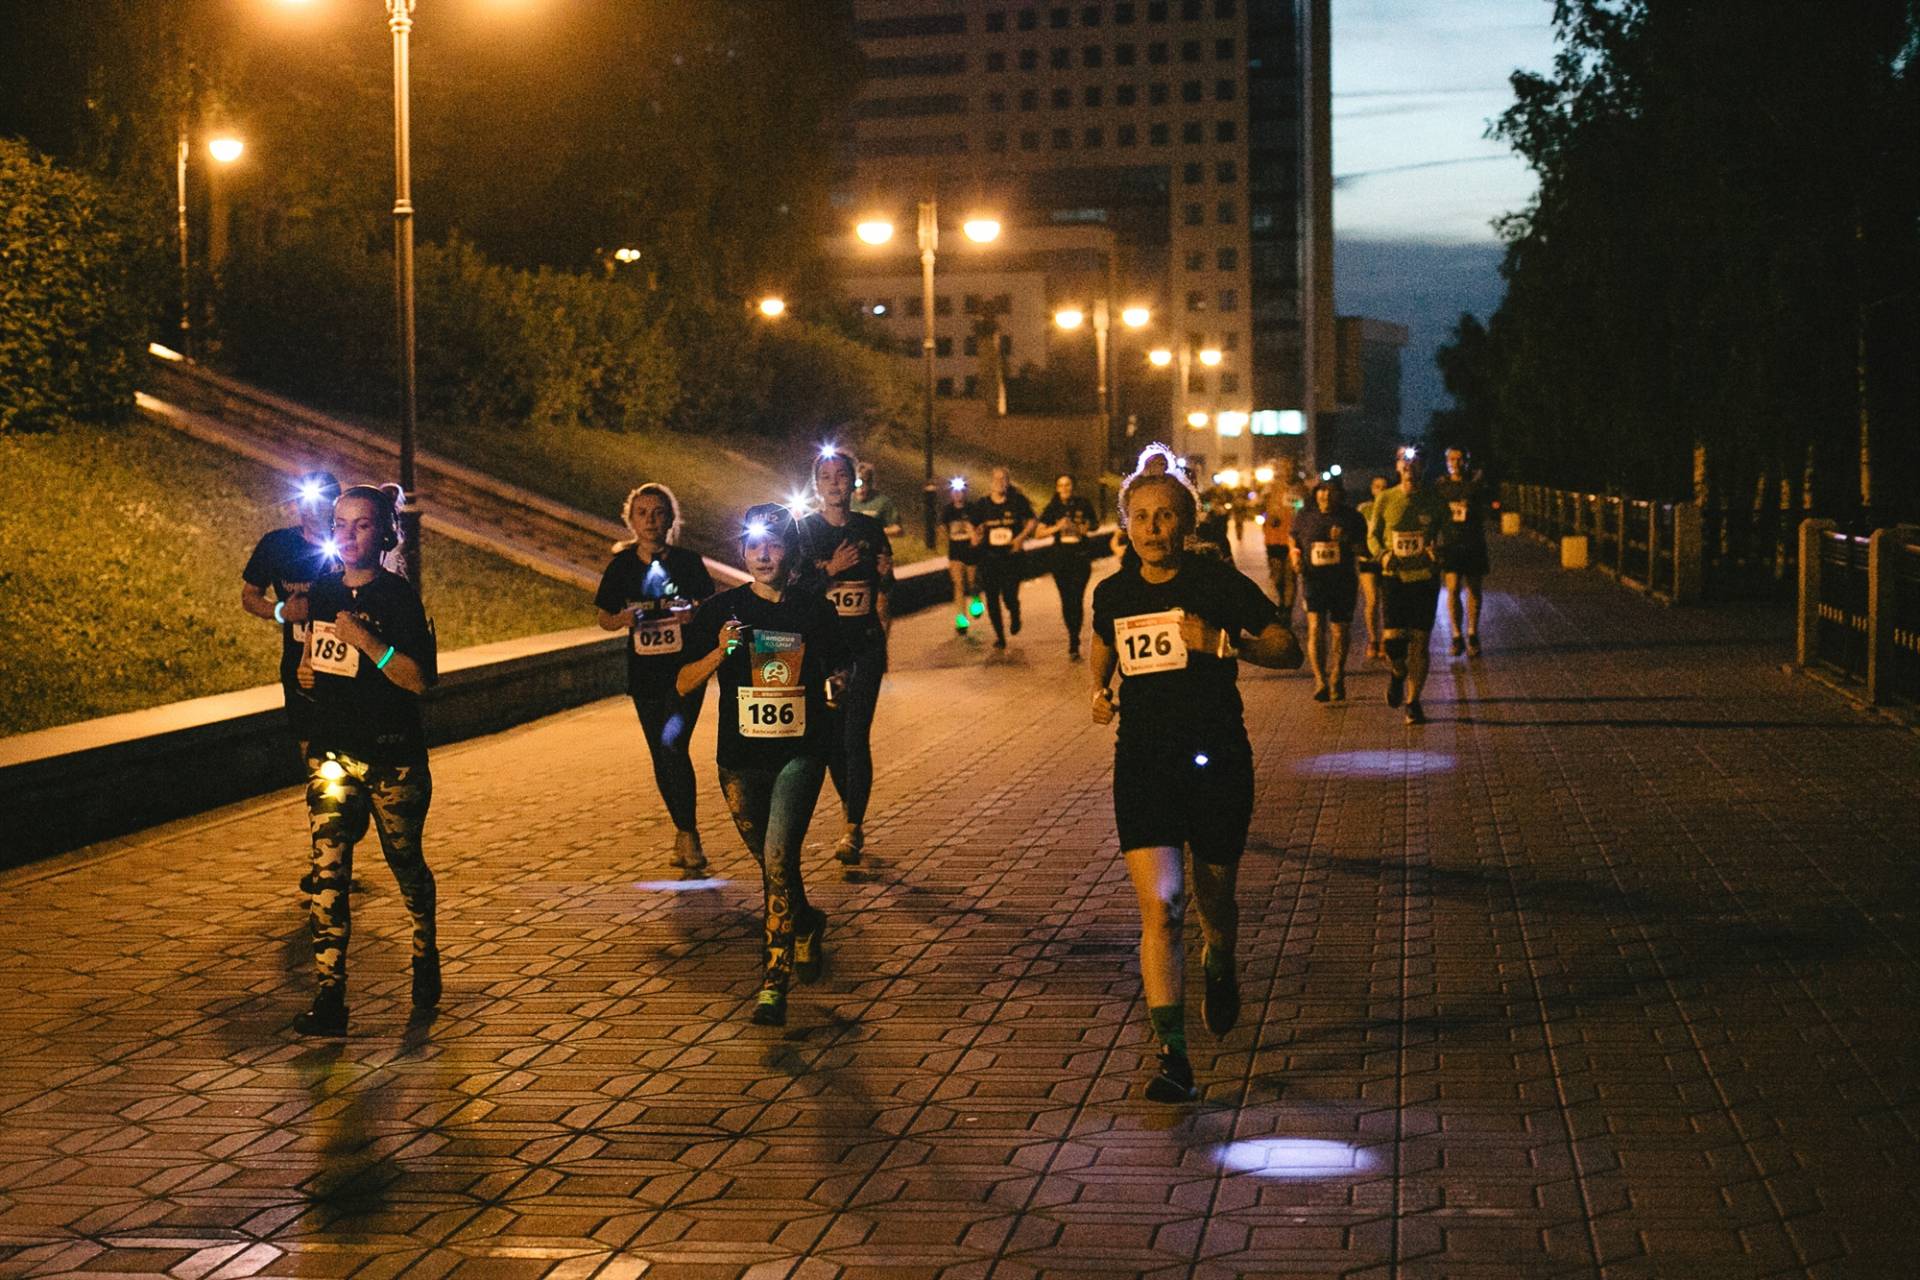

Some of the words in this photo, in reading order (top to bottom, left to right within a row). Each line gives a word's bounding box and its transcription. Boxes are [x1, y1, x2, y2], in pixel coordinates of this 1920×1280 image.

[833, 592, 865, 607] 167
[640, 629, 676, 646] 028
[1124, 631, 1172, 660] 126
[314, 638, 348, 662] 189
[748, 703, 795, 725] 186
